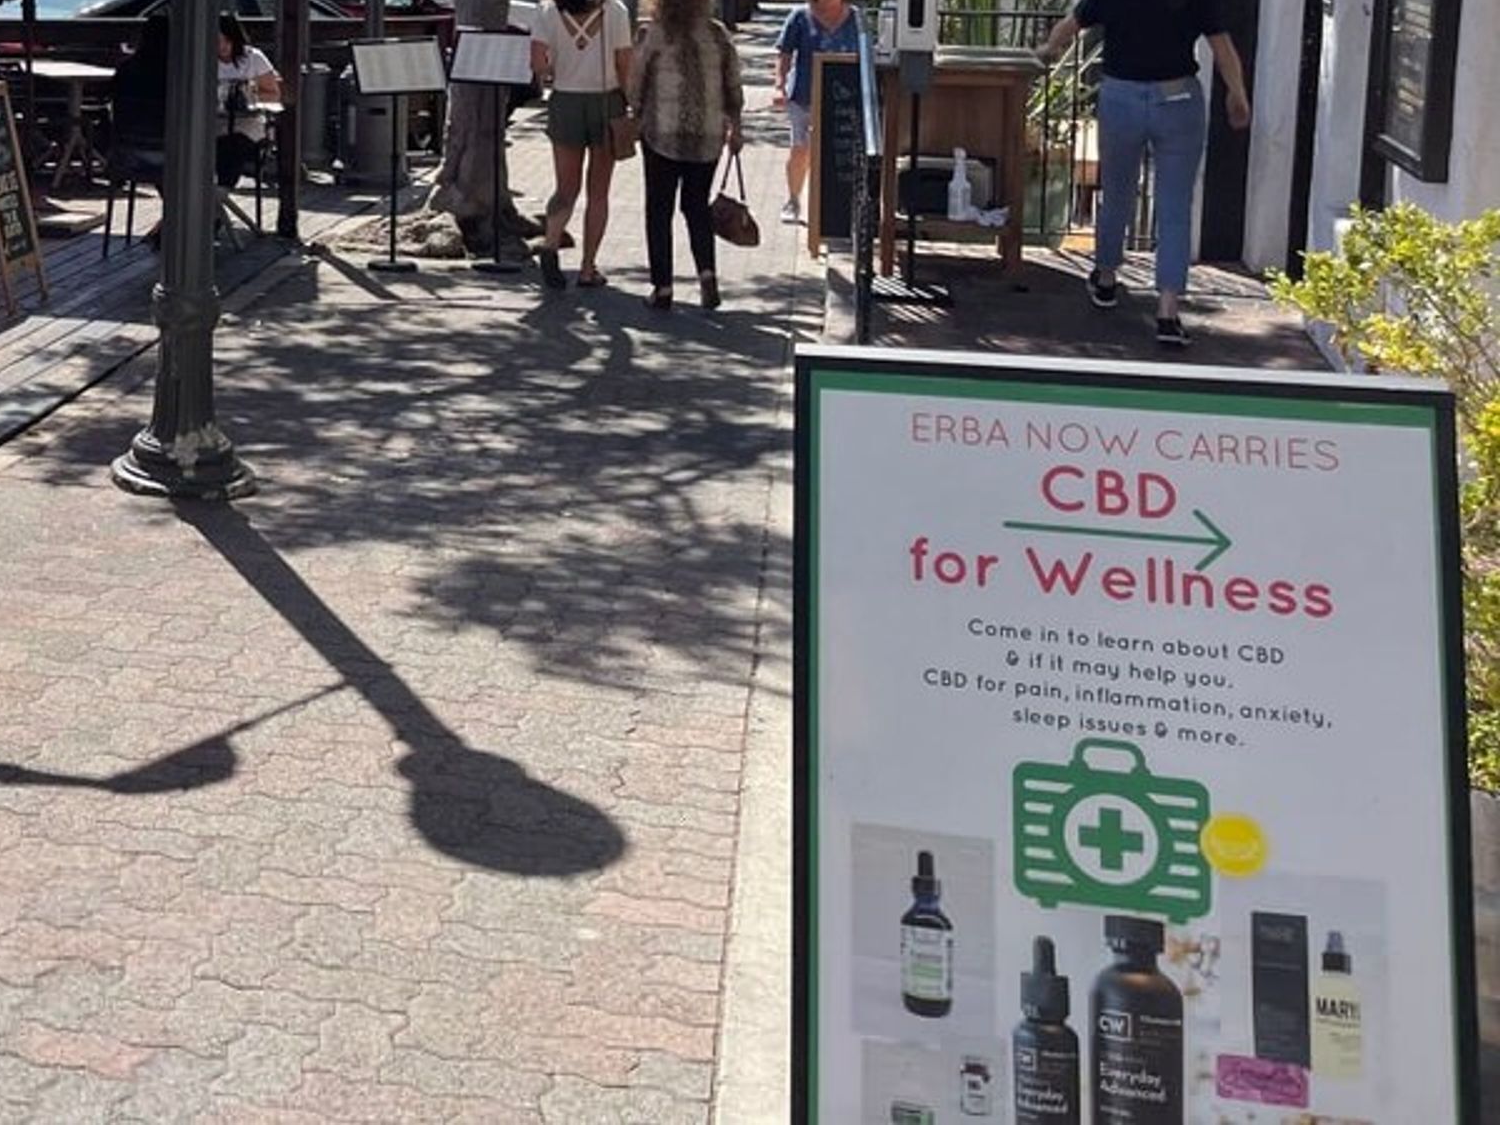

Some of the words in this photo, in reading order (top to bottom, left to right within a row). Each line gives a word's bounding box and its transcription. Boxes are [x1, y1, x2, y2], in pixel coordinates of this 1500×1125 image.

[912, 413, 1008, 446] ERBA
[1027, 421, 1139, 456] NOW
[1157, 431, 1339, 471] CARRIES
[1042, 466, 1176, 518] CBD
[911, 537, 998, 586] for
[1026, 548, 1333, 618] Wellness
[968, 617, 1032, 640] Come
[1041, 626, 1059, 643] in
[1068, 628, 1089, 646] to
[1098, 631, 1154, 652] learn
[1162, 639, 1228, 659] about
[1238, 644, 1284, 664] CBD
[1030, 652, 1042, 668] if
[1050, 654, 1063, 671] it
[1073, 659, 1119, 681] may
[1129, 661, 1176, 685] help
[1184, 672, 1233, 688] you.
[923, 667, 967, 688] CBD
[977, 674, 1006, 692] for
[1015, 682, 1069, 702] pain,
[1076, 683, 1233, 719] inflammation,
[1240, 705, 1333, 730] anxiety,
[1013, 706, 1070, 730] sleep
[1080, 712, 1146, 736] issues
[1178, 725, 1245, 747] more.
